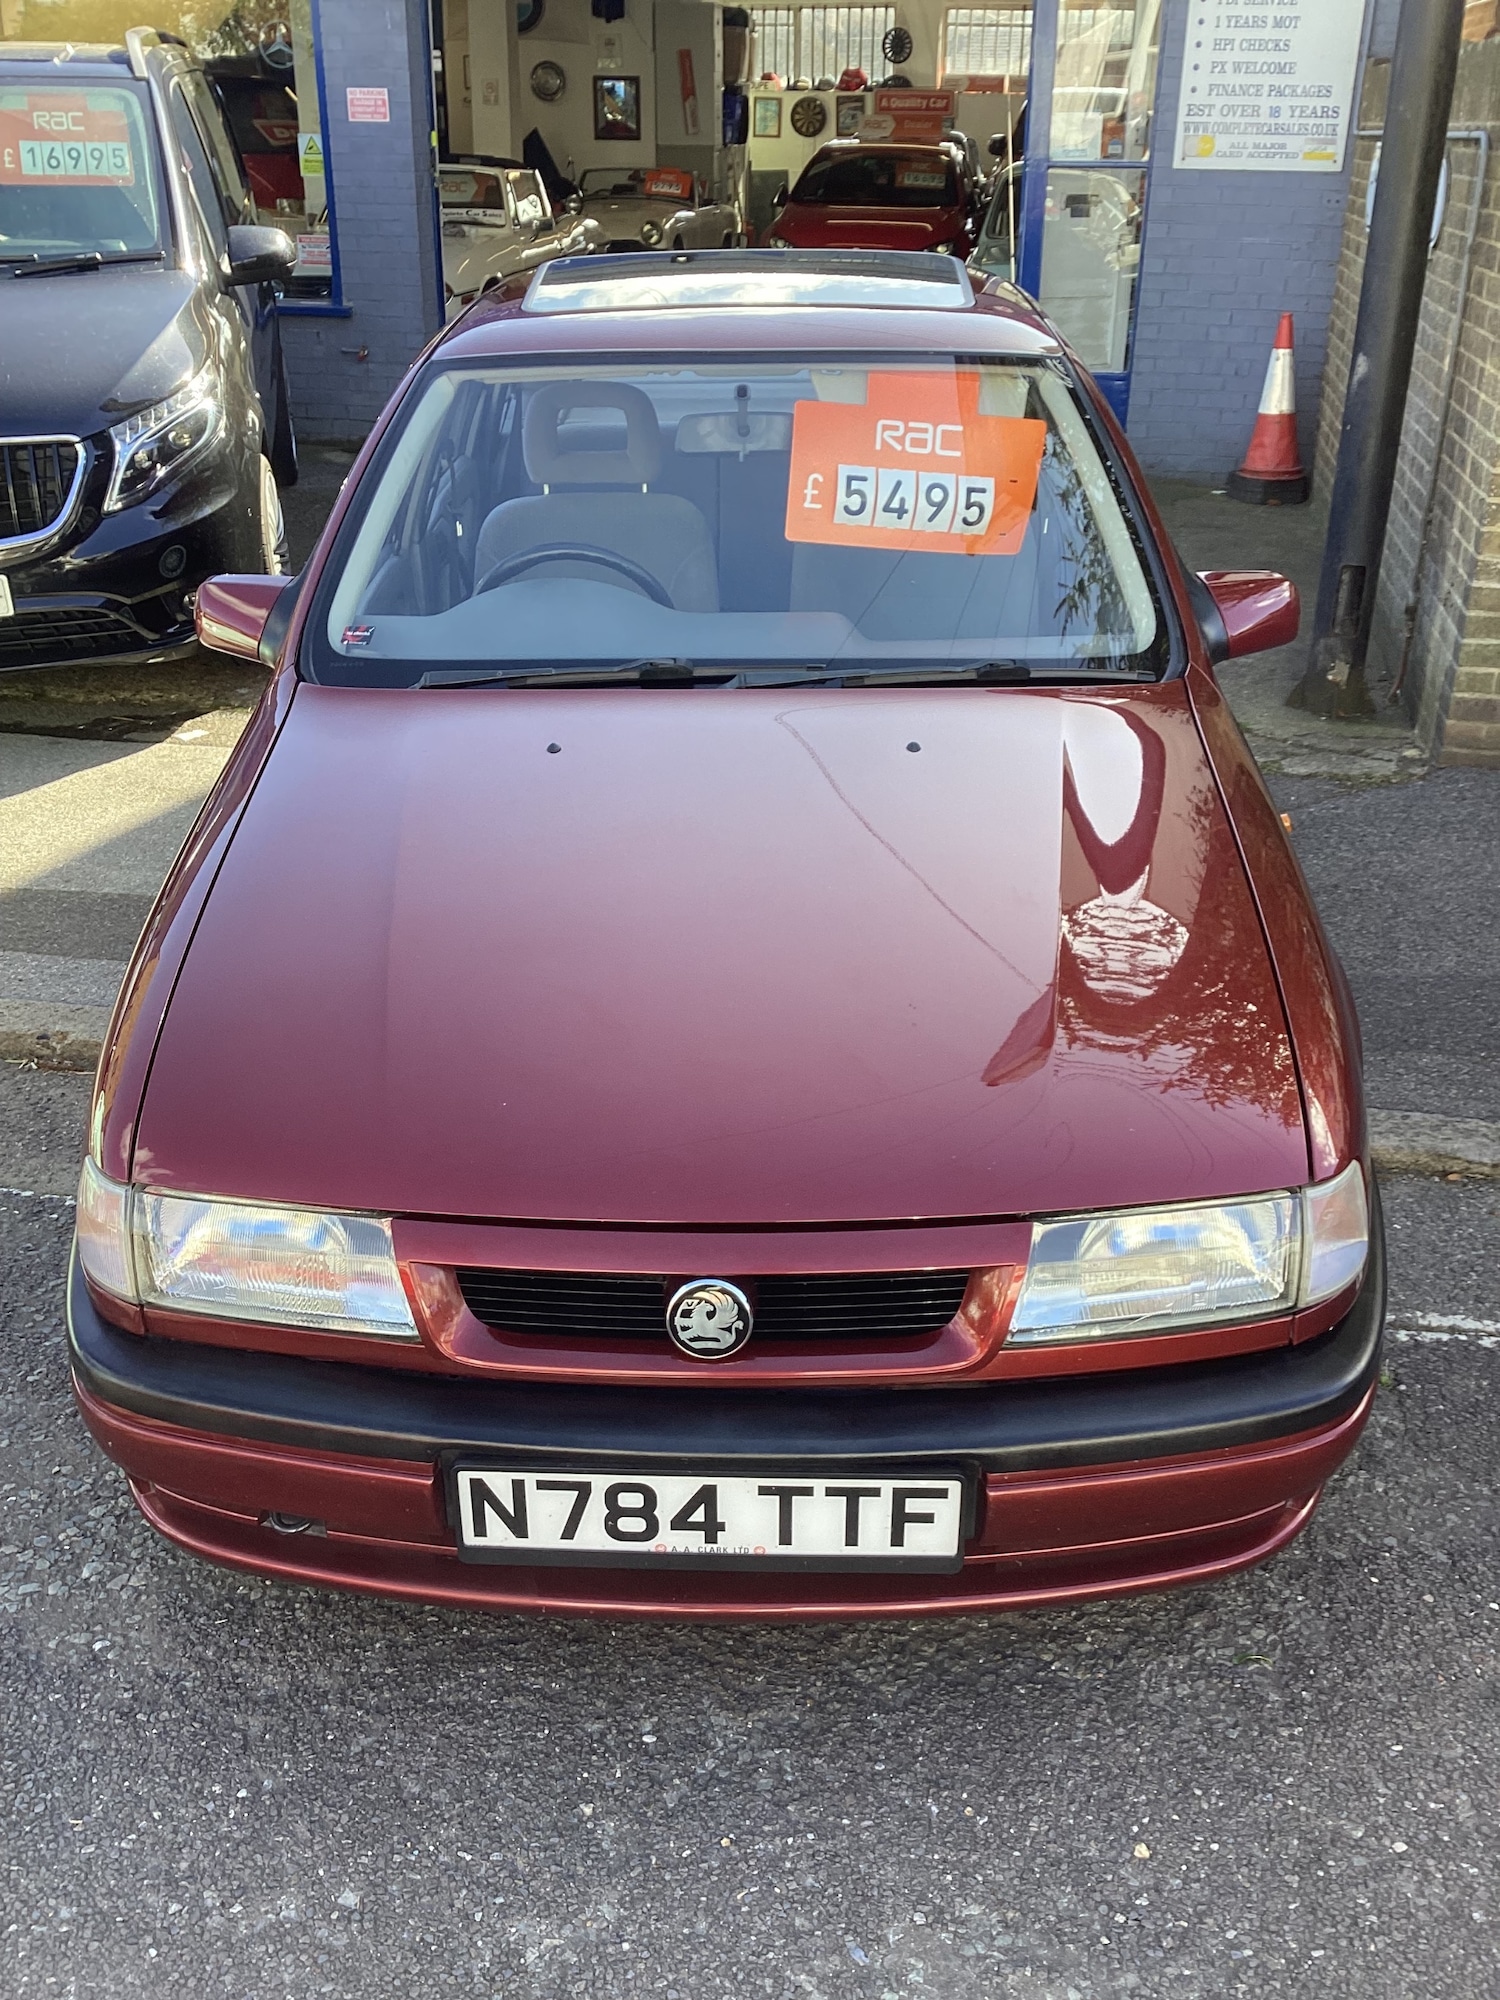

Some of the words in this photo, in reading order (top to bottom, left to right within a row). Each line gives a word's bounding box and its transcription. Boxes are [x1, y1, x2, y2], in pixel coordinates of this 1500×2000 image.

[1215, 16, 1220, 28] 1
[1226, 15, 1268, 28] YEARS
[1272, 15, 1300, 28] MOT
[1212, 38, 1235, 51] HPI
[1239, 38, 1291, 51] CHECKS
[1209, 61, 1227, 74] PX
[1232, 61, 1297, 75] WELCOME
[1207, 84, 1263, 97] FINANCE
[1267, 84, 1333, 97] PACKAGES
[890, 97, 927, 109] Quality
[929, 98, 947, 108] Car
[1185, 103, 1216, 117] EST
[1220, 104, 1261, 118] OVER
[1268, 105, 1281, 119] 18
[1289, 105, 1340, 119] YEARS
[1183, 121, 1339, 137] WWW.COMPLETECARSALES.CO.UK
[1229, 142, 1248, 150] ALL
[1252, 142, 1287, 150] MAJOR
[1246, 151, 1300, 159] ACCEPTED
[468, 1477, 727, 1545] N784
[757, 1484, 949, 1548] TTF
[697, 1546, 729, 1555] CLARK
[733, 1546, 750, 1555] LTD
